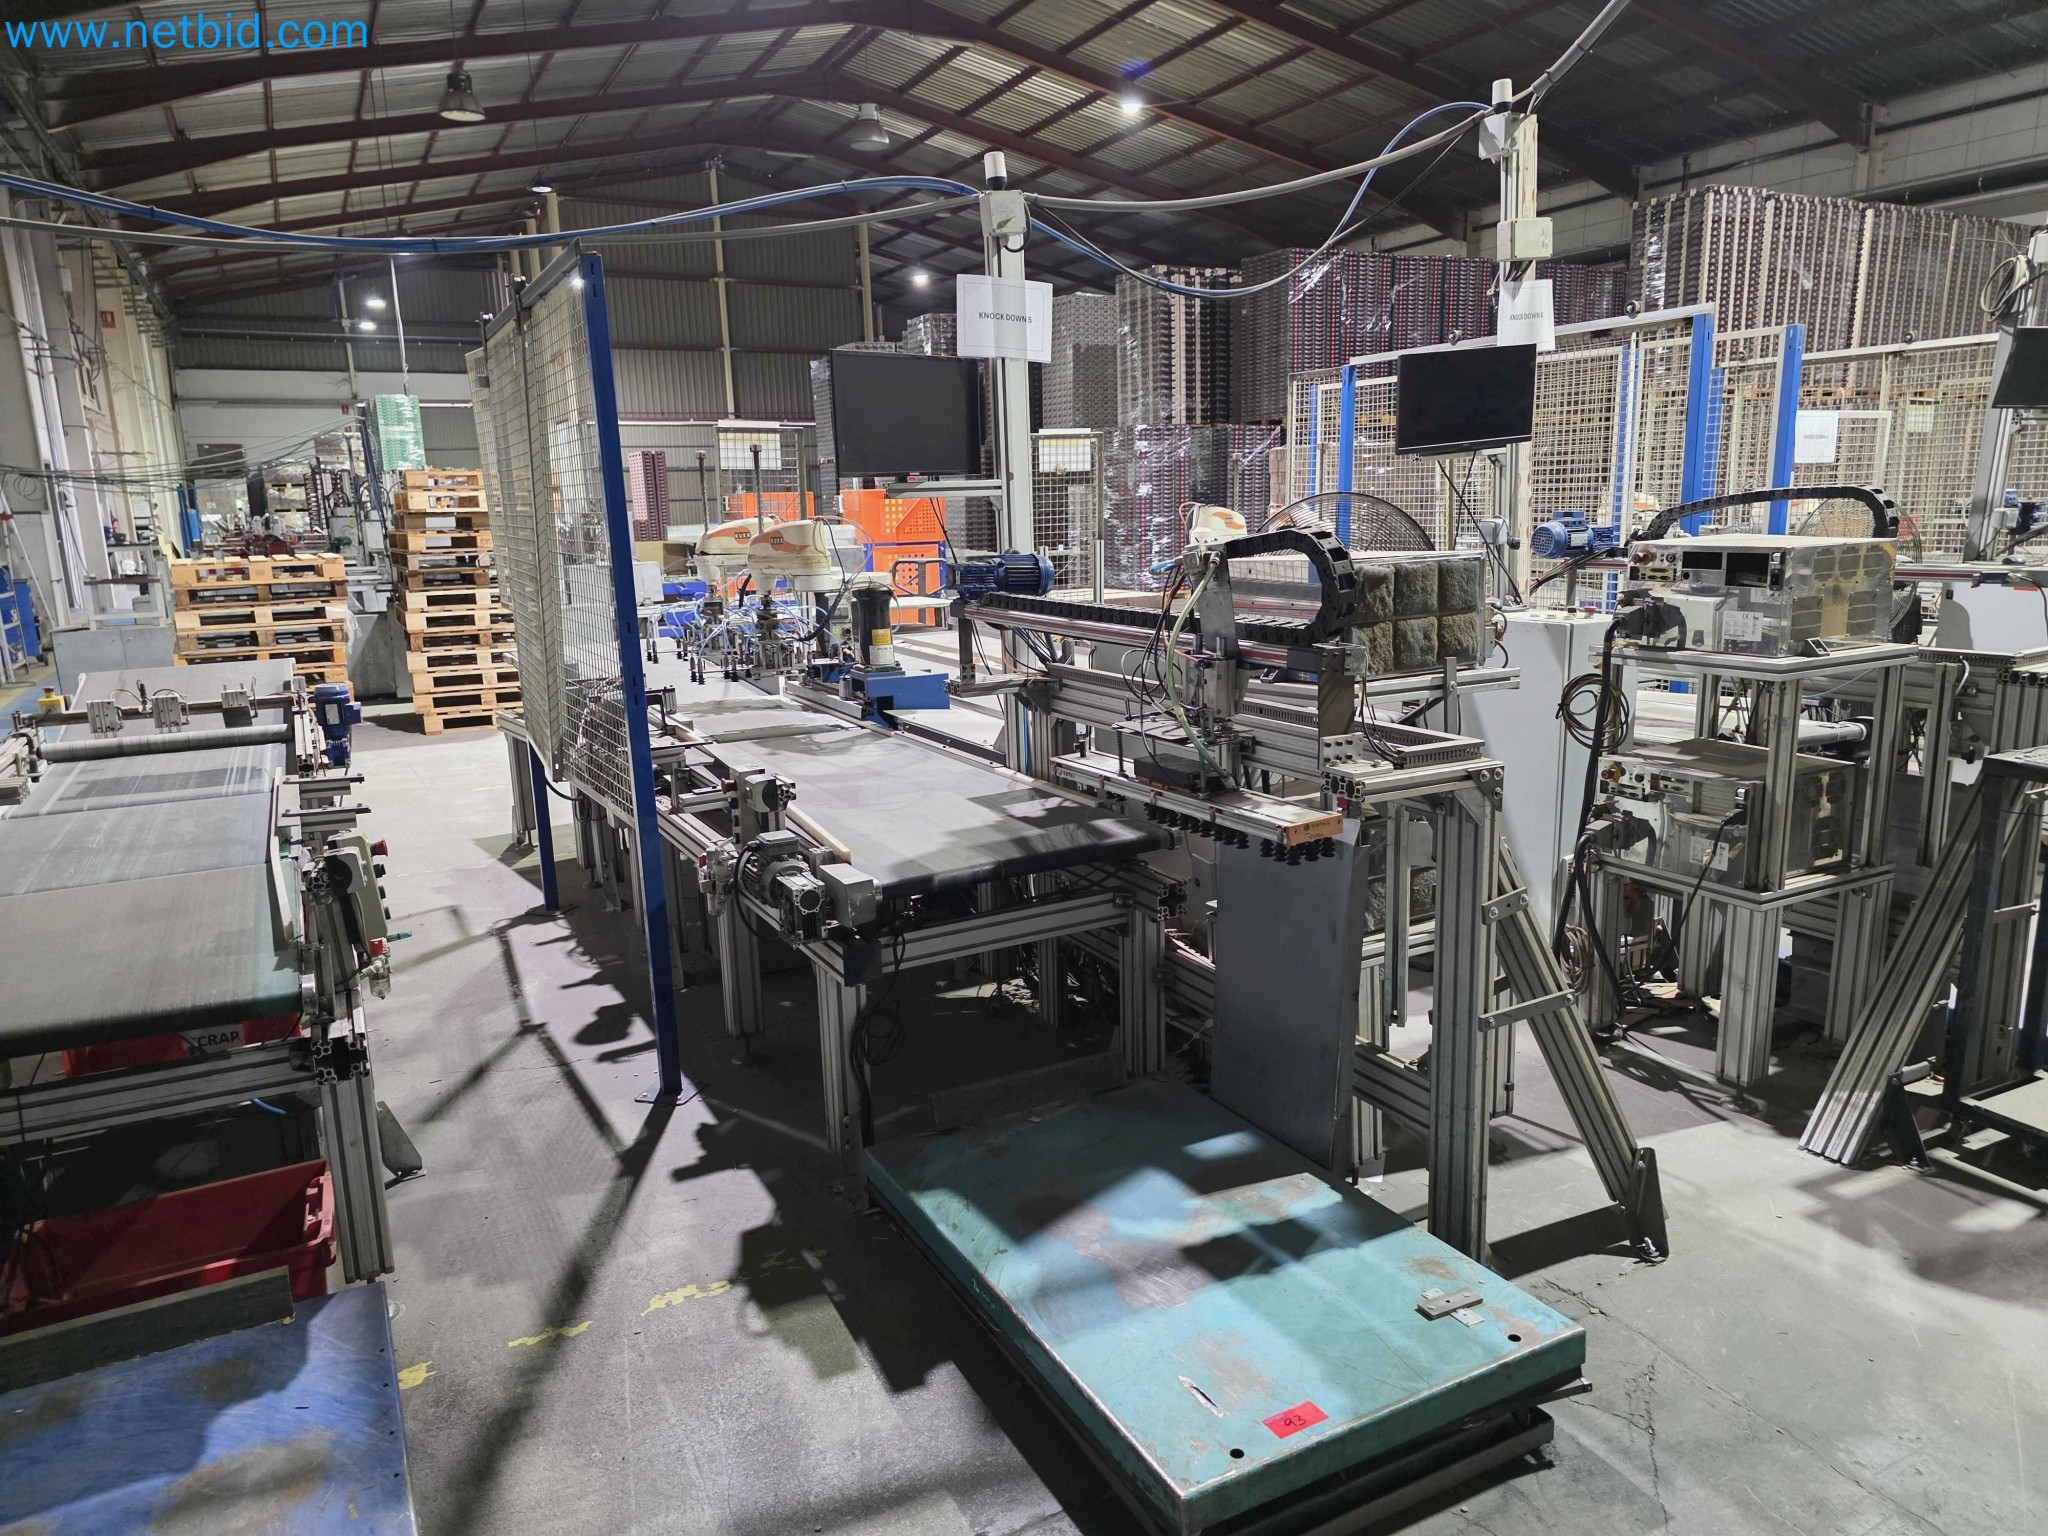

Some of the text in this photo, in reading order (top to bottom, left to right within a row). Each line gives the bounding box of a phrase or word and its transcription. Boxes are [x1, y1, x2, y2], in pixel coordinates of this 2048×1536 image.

[979, 312, 1005, 320] KNOCK
[1005, 314, 1027, 323] DOWN
[1524, 312, 1540, 320] DOWN
[192, 1031, 240, 1047] CRAP
[1284, 1415, 1306, 1426] 93
